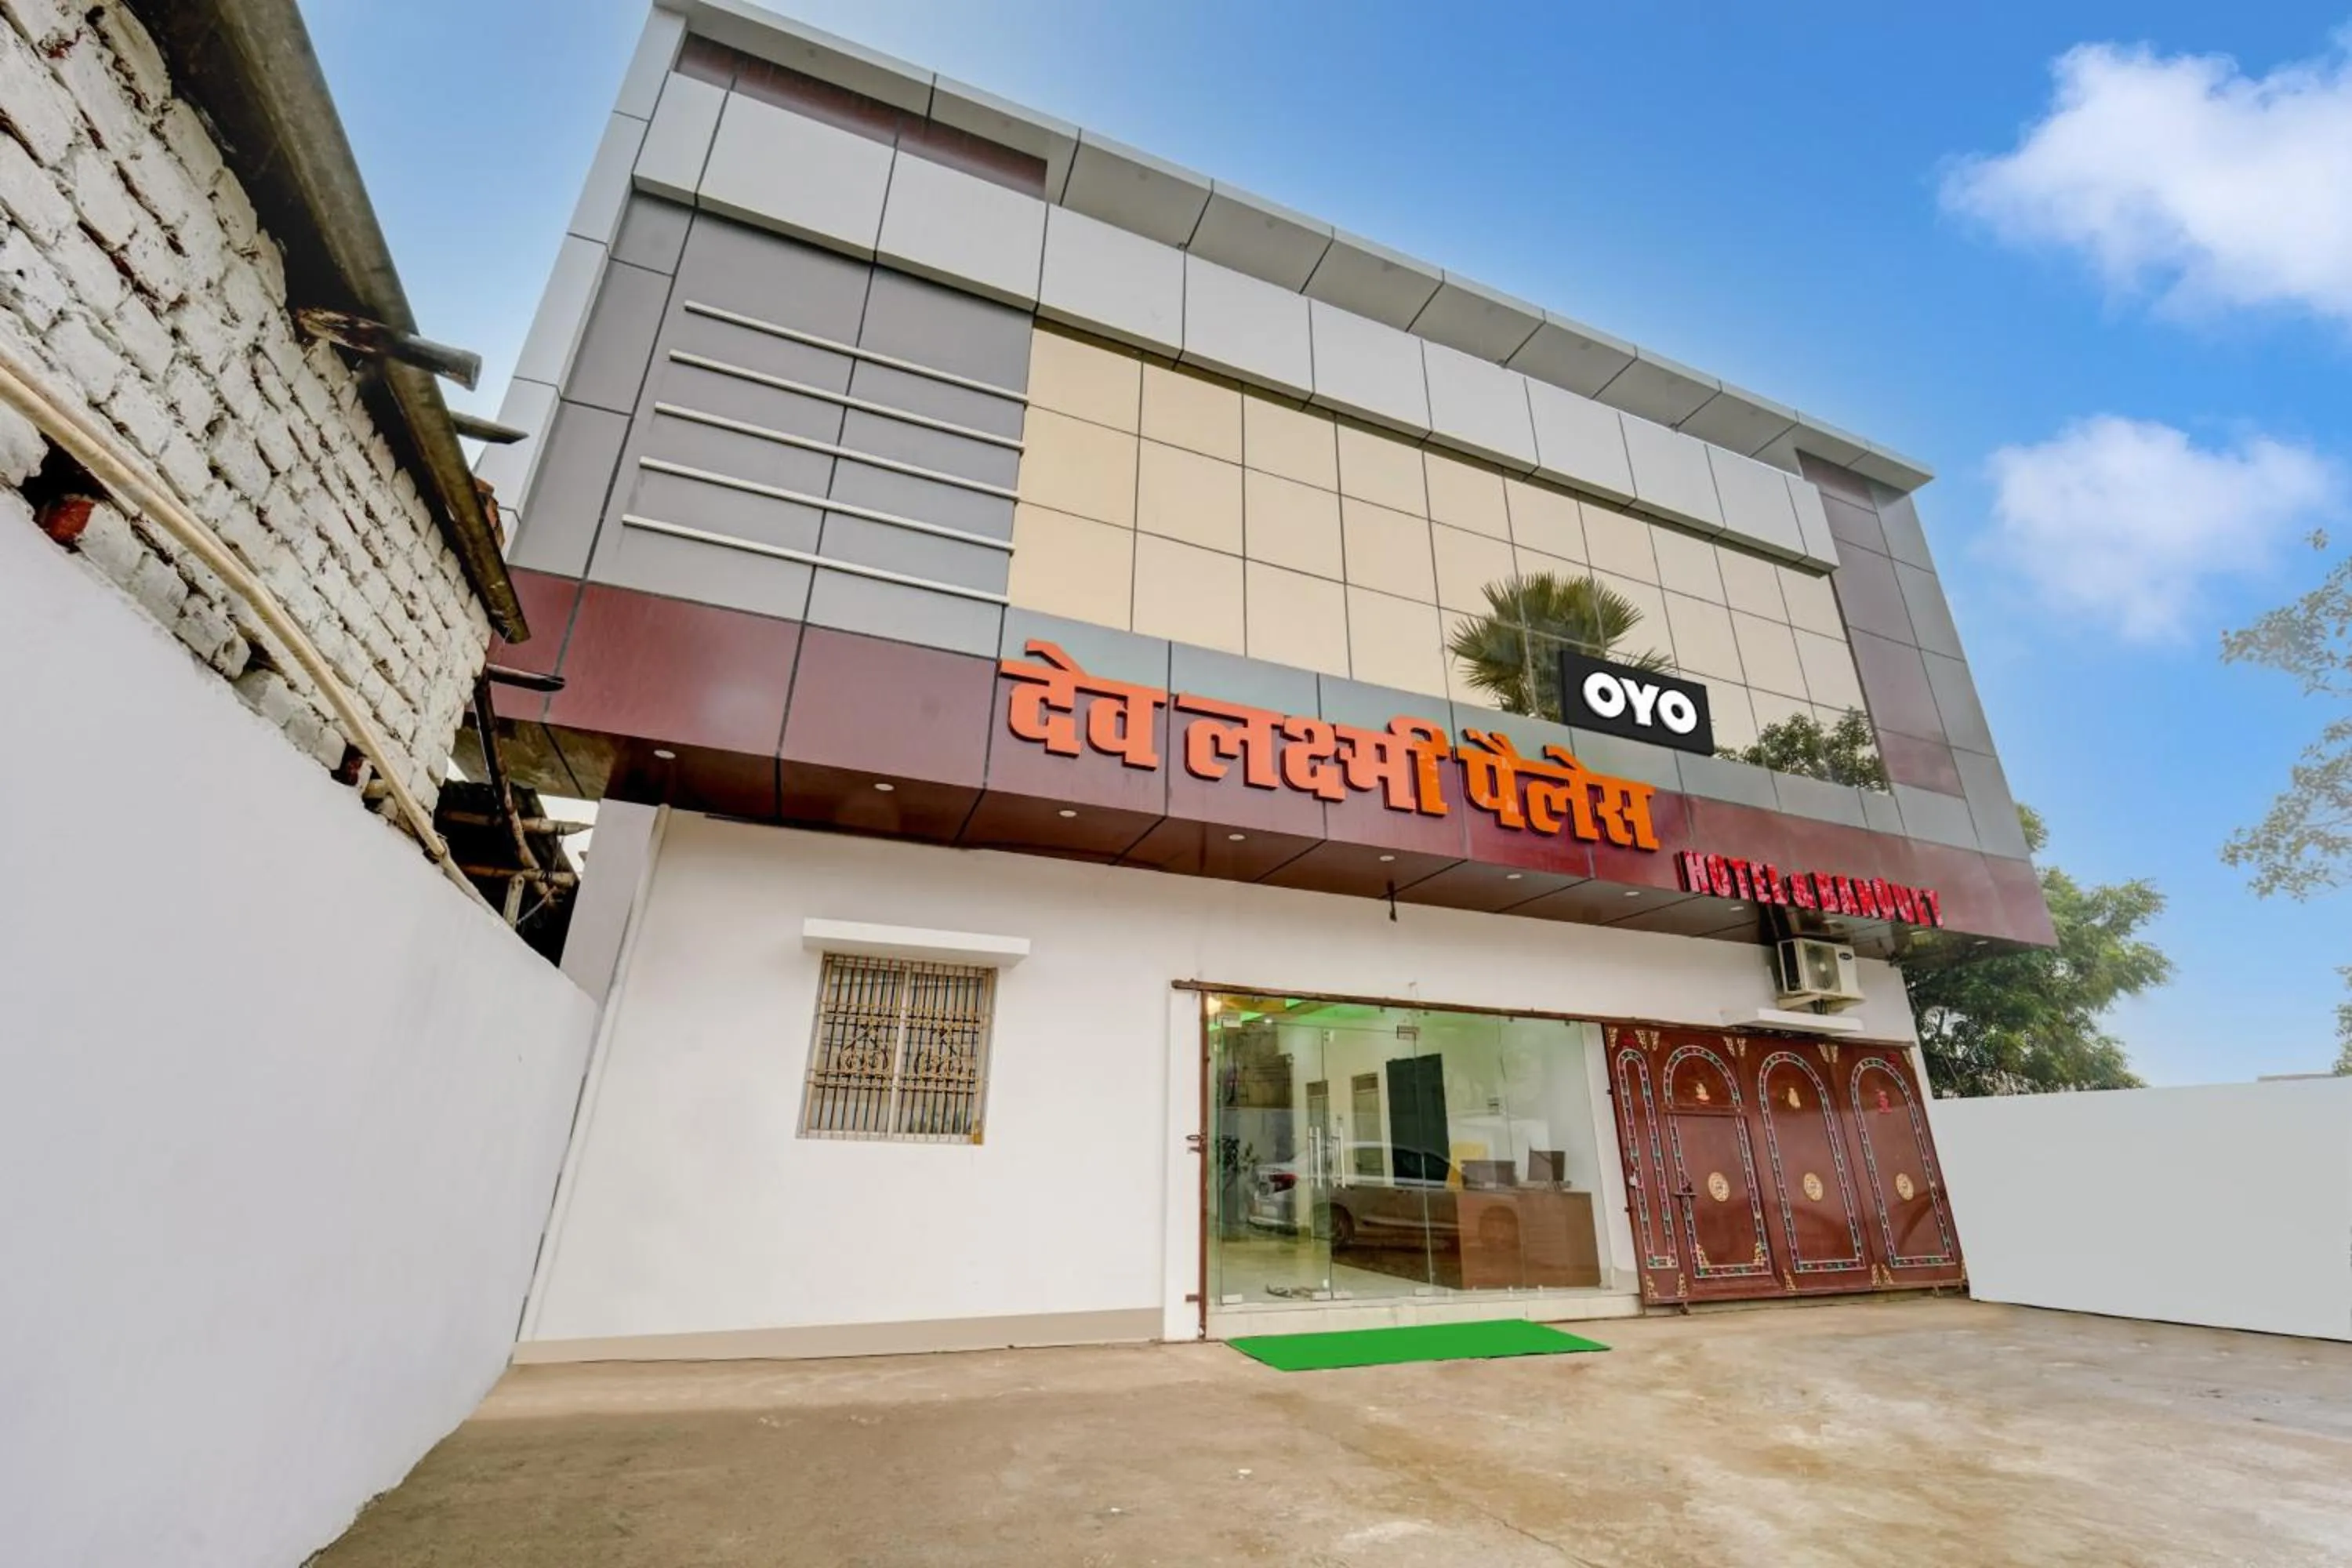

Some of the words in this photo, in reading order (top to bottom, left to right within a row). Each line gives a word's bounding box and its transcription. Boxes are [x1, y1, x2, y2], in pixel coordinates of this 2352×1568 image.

[1582, 671, 1698, 735] OYO
[998, 637, 1167, 771] देव
[1174, 692, 1453, 817] लक्ष्मी
[1454, 727, 1660, 852] पैलेस
[1678, 850, 1789, 905] HOTEL
